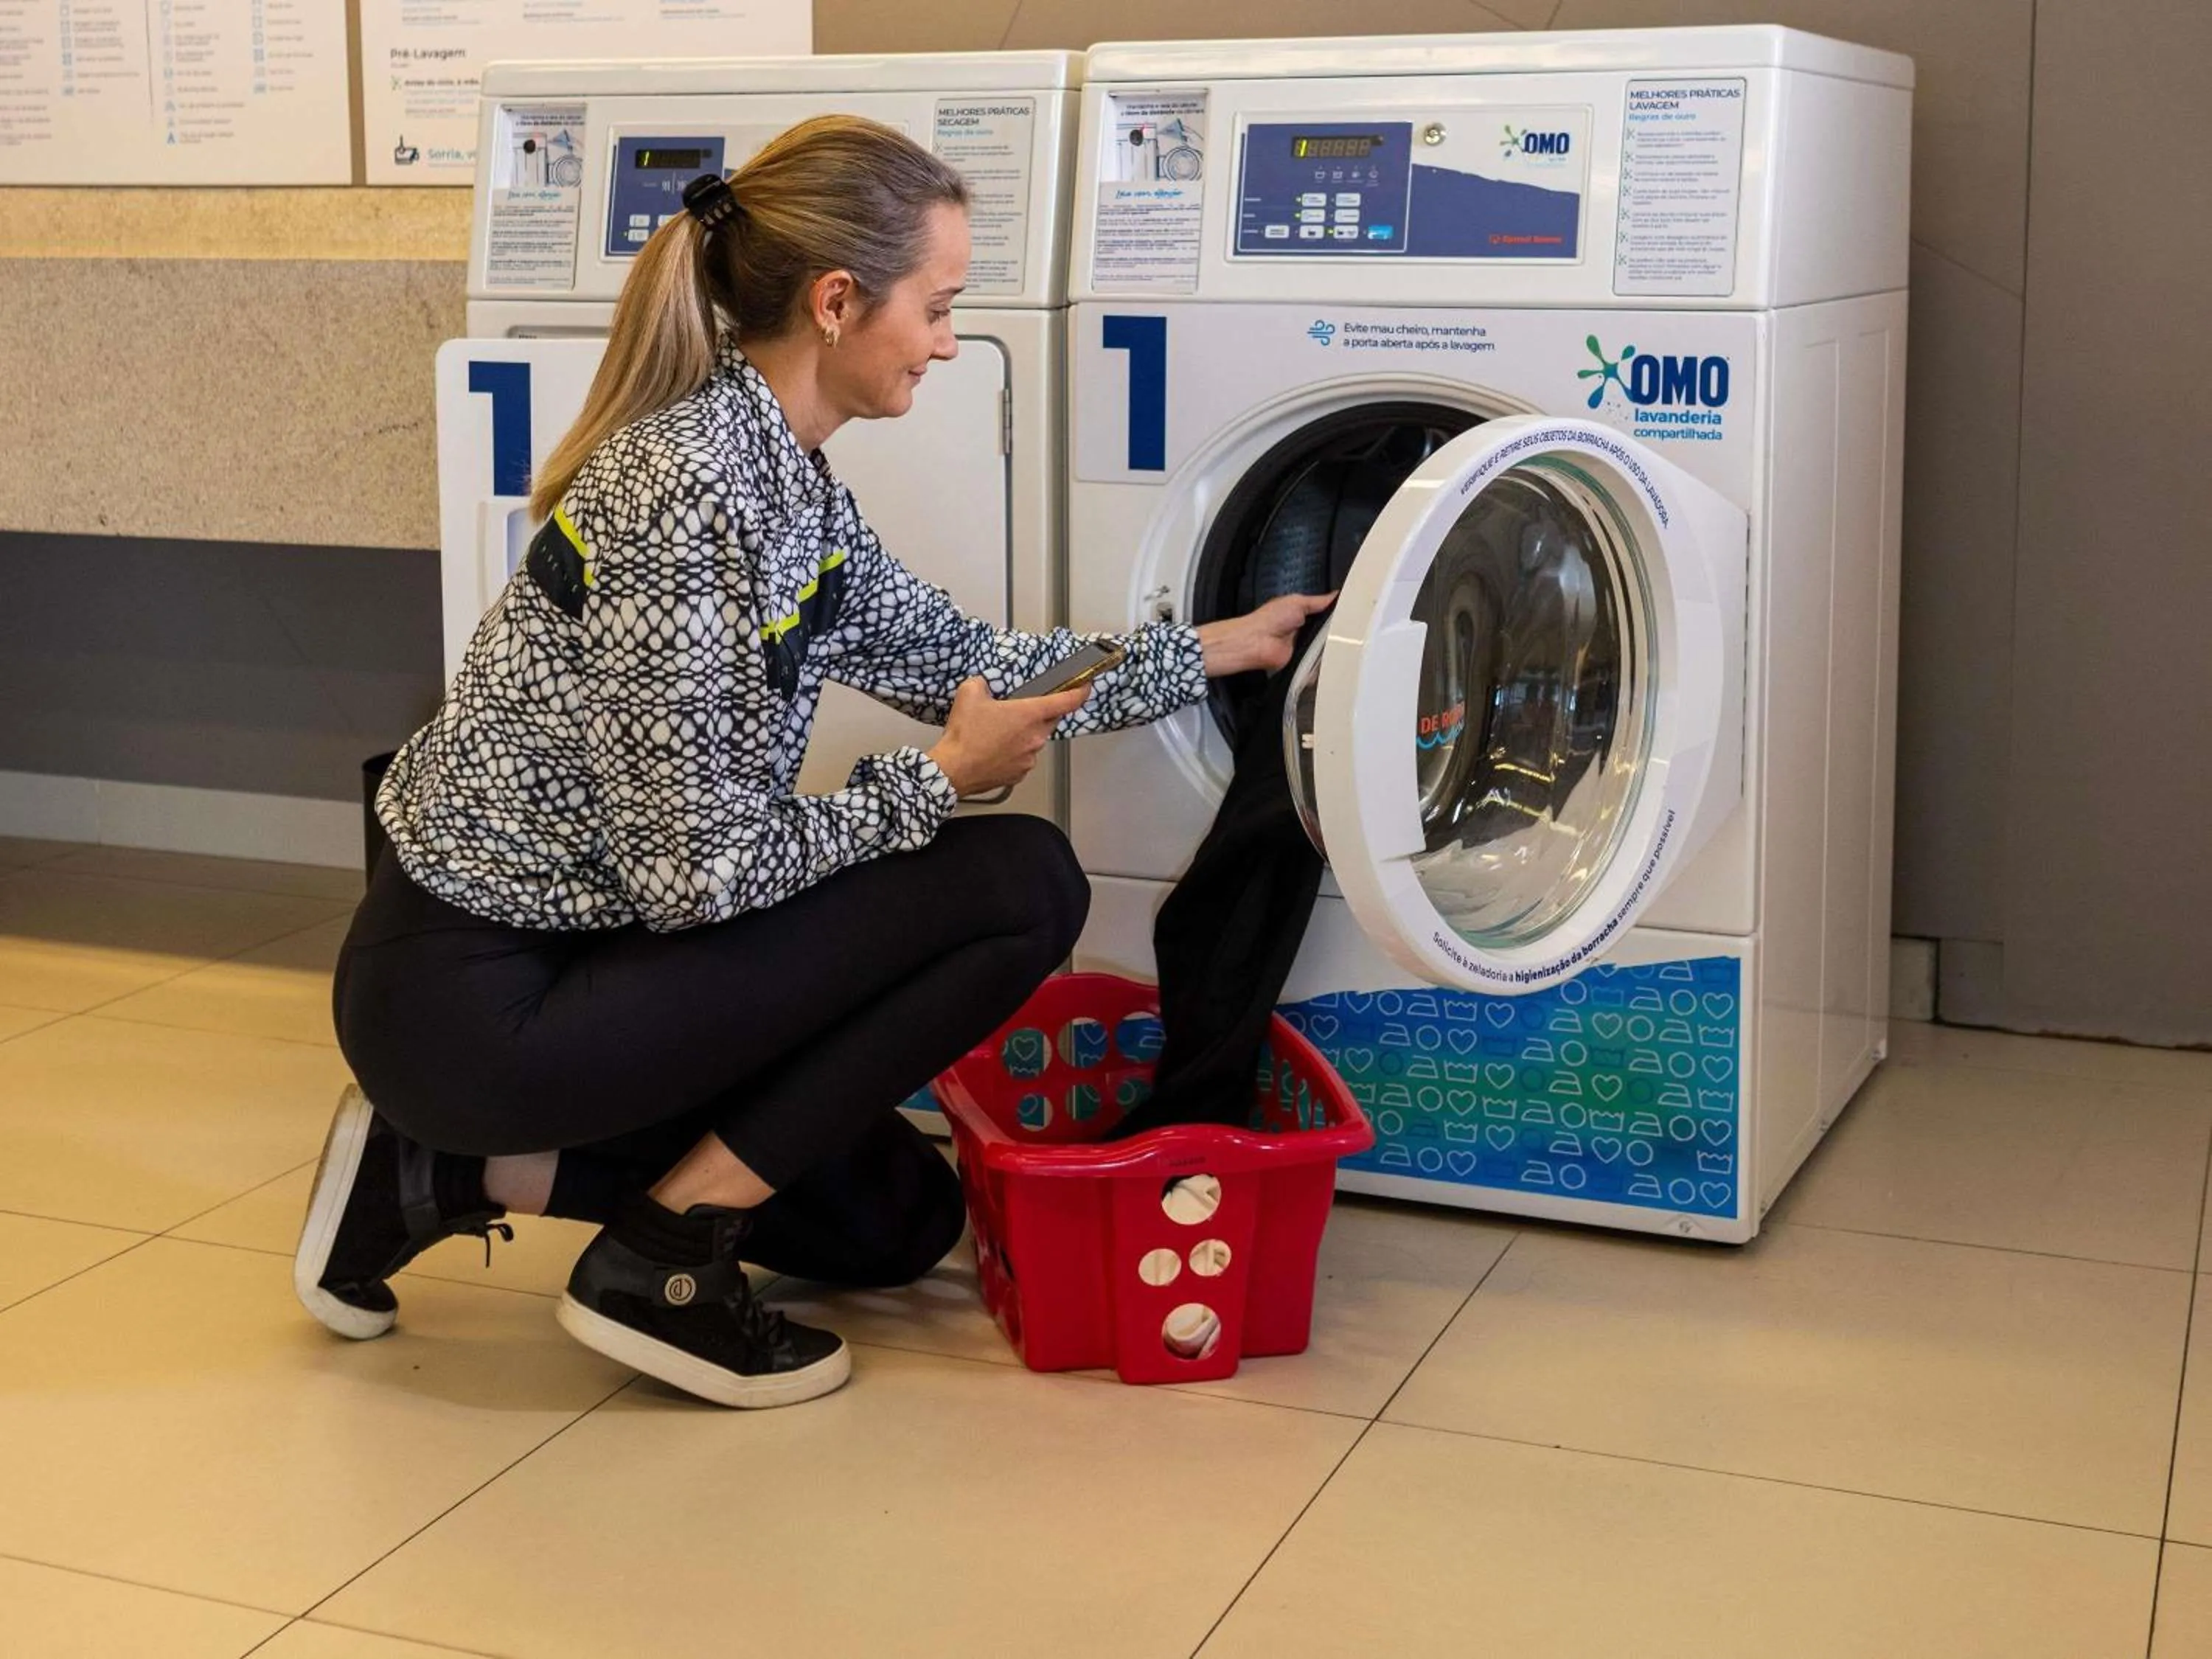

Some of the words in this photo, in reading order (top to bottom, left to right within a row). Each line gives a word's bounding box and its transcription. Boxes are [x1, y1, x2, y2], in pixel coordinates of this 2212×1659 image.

[1630, 90, 1687, 100] MELHORES
[1689, 88, 1741, 98] PRÁTICAS
[938, 108, 986, 116] MELHORES
[987, 106, 1030, 116] PRÁTICAS
[1629, 102, 1679, 111] LAVAGEM
[937, 118, 979, 126] SECAGEM
[1629, 113, 1659, 122] Regras
[1524, 132, 1570, 154] OMO
[1343, 323, 1368, 333] Evite
[1371, 326, 1394, 334] mau
[1396, 324, 1430, 336] cheiro,
[1431, 326, 1486, 336] mantenha
[1352, 338, 1378, 349] porta
[1380, 338, 1413, 349] aberta
[1415, 339, 1439, 351] após
[1450, 341, 1495, 352] lavagem
[1630, 354, 1729, 407] OMO
[1103, 316, 1167, 472] 1
[1634, 408, 1722, 425] lavanderia
[468, 361, 532, 497] 1
[1633, 427, 1722, 441] compartilhada
[1523, 433, 1539, 448] SEUS
[1577, 431, 1609, 451] BORRACHA
[1629, 459, 1641, 476] USO
[1433, 931, 1462, 964] Solicite
[1462, 957, 1468, 967] à
[1468, 961, 1507, 982] zeladoria
[1509, 973, 1514, 982] a
[1515, 959, 1571, 984] higienização
[1571, 952, 1582, 964] da
[1582, 918, 1619, 956] borracha
[1617, 881, 1644, 920] sempre
[1642, 859, 1656, 882] que
[1653, 809, 1676, 860] possível
